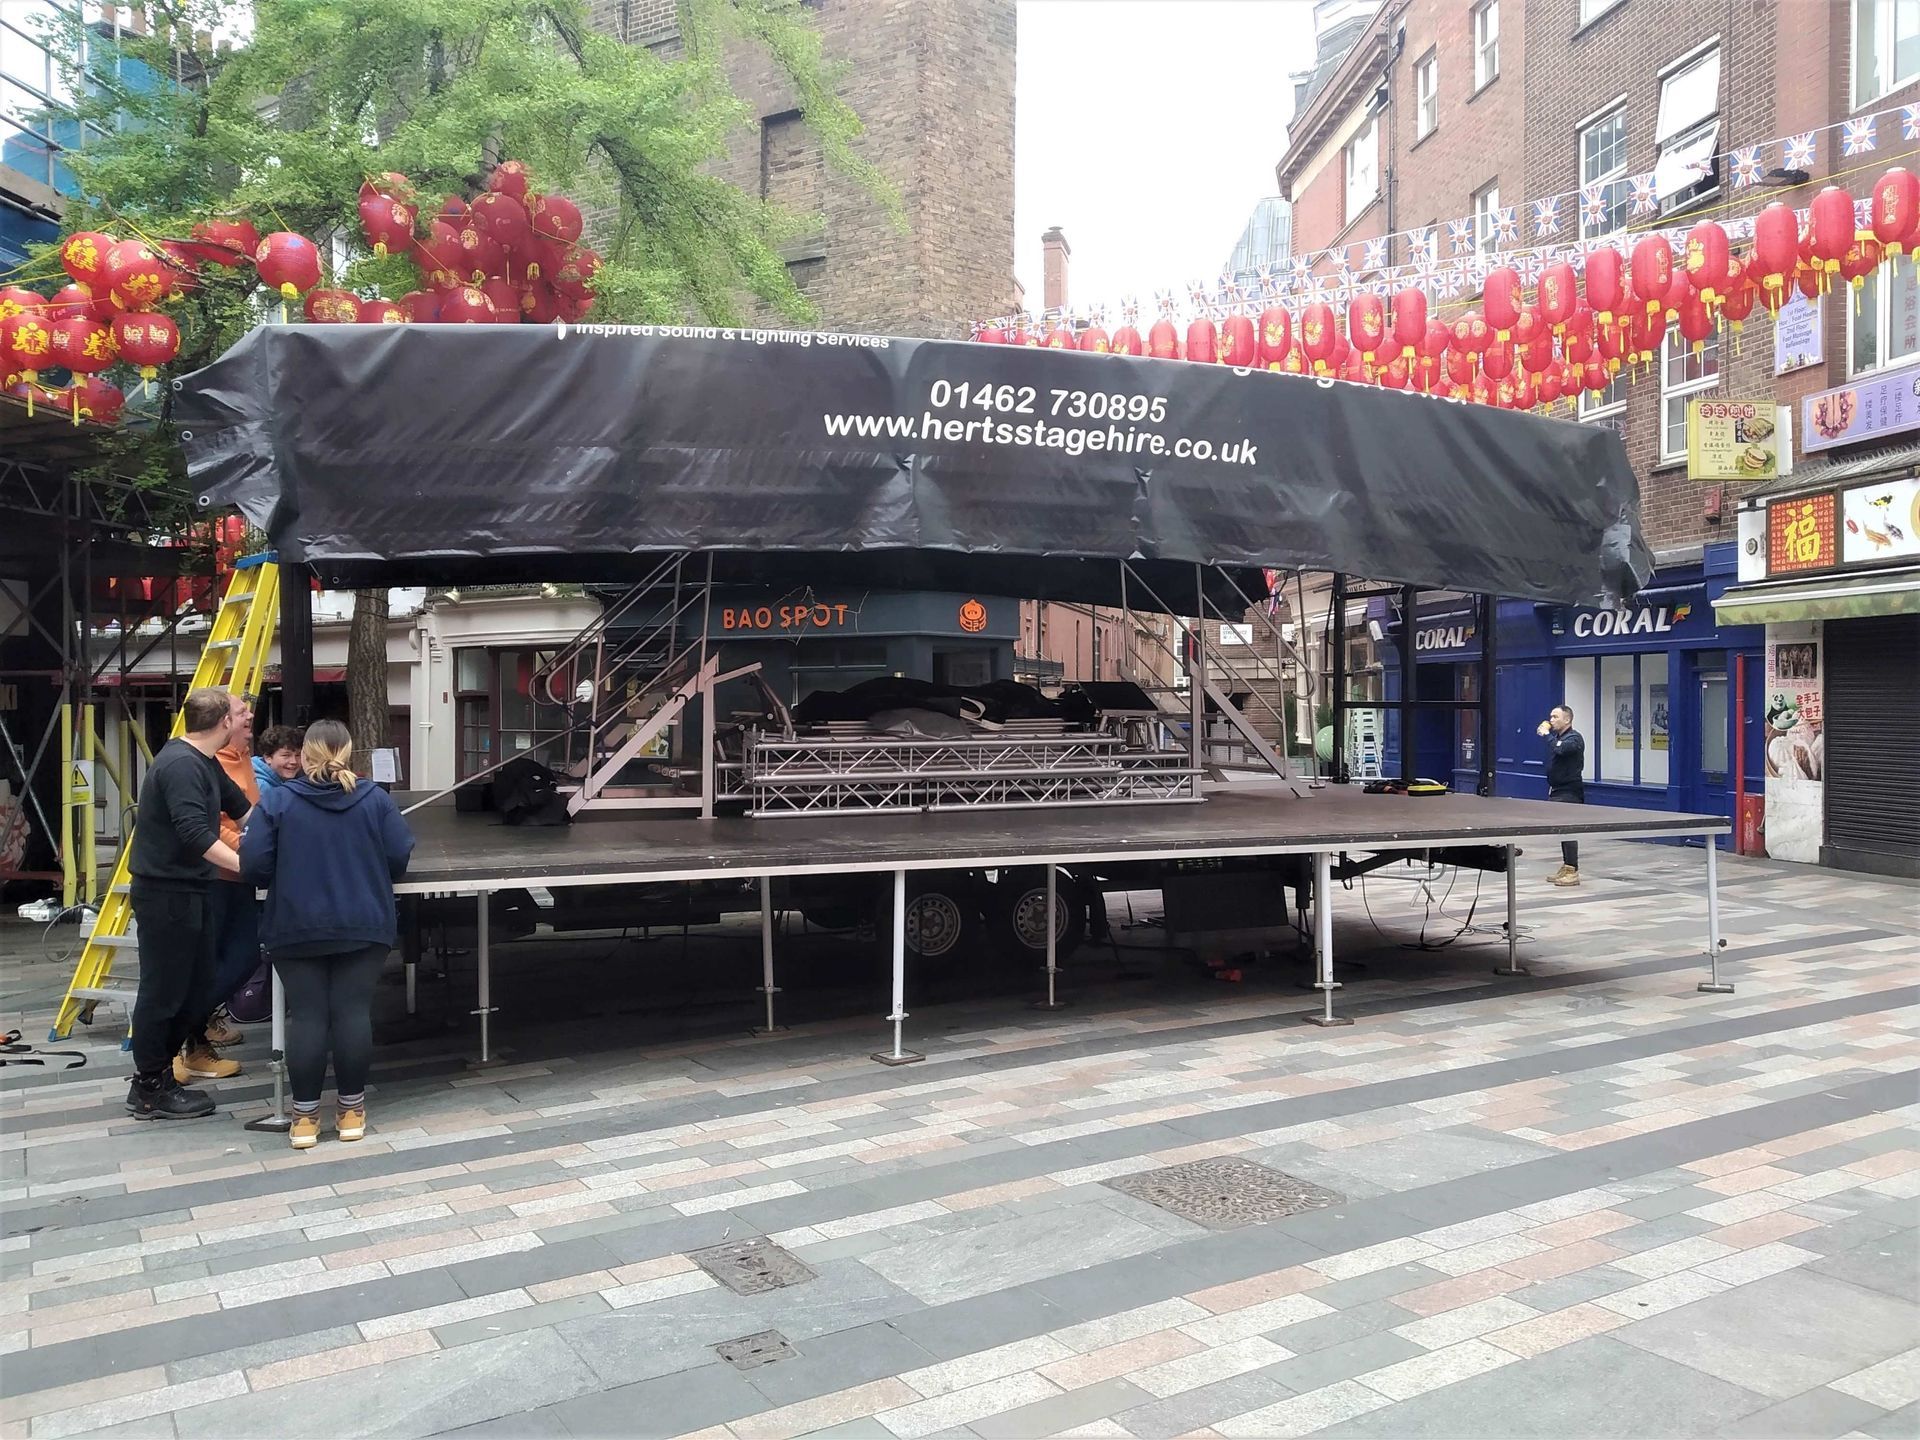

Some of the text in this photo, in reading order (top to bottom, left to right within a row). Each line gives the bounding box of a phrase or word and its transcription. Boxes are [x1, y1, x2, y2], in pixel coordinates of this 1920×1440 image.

[576, 324, 890, 348] Inspired Sound & Lighting Services
[930, 379, 1168, 422] 01462 730895
[823, 411, 1258, 466] www.hertsstagehire.co.uk
[1784, 504, 1820, 562] 福
[723, 603, 848, 629] BAO SPOT
[1574, 607, 1671, 638] CORAL
[1416, 626, 1466, 650] CORAL
[1796, 692, 1820, 706] 全手工
[1797, 705, 1821, 719] 大包子
